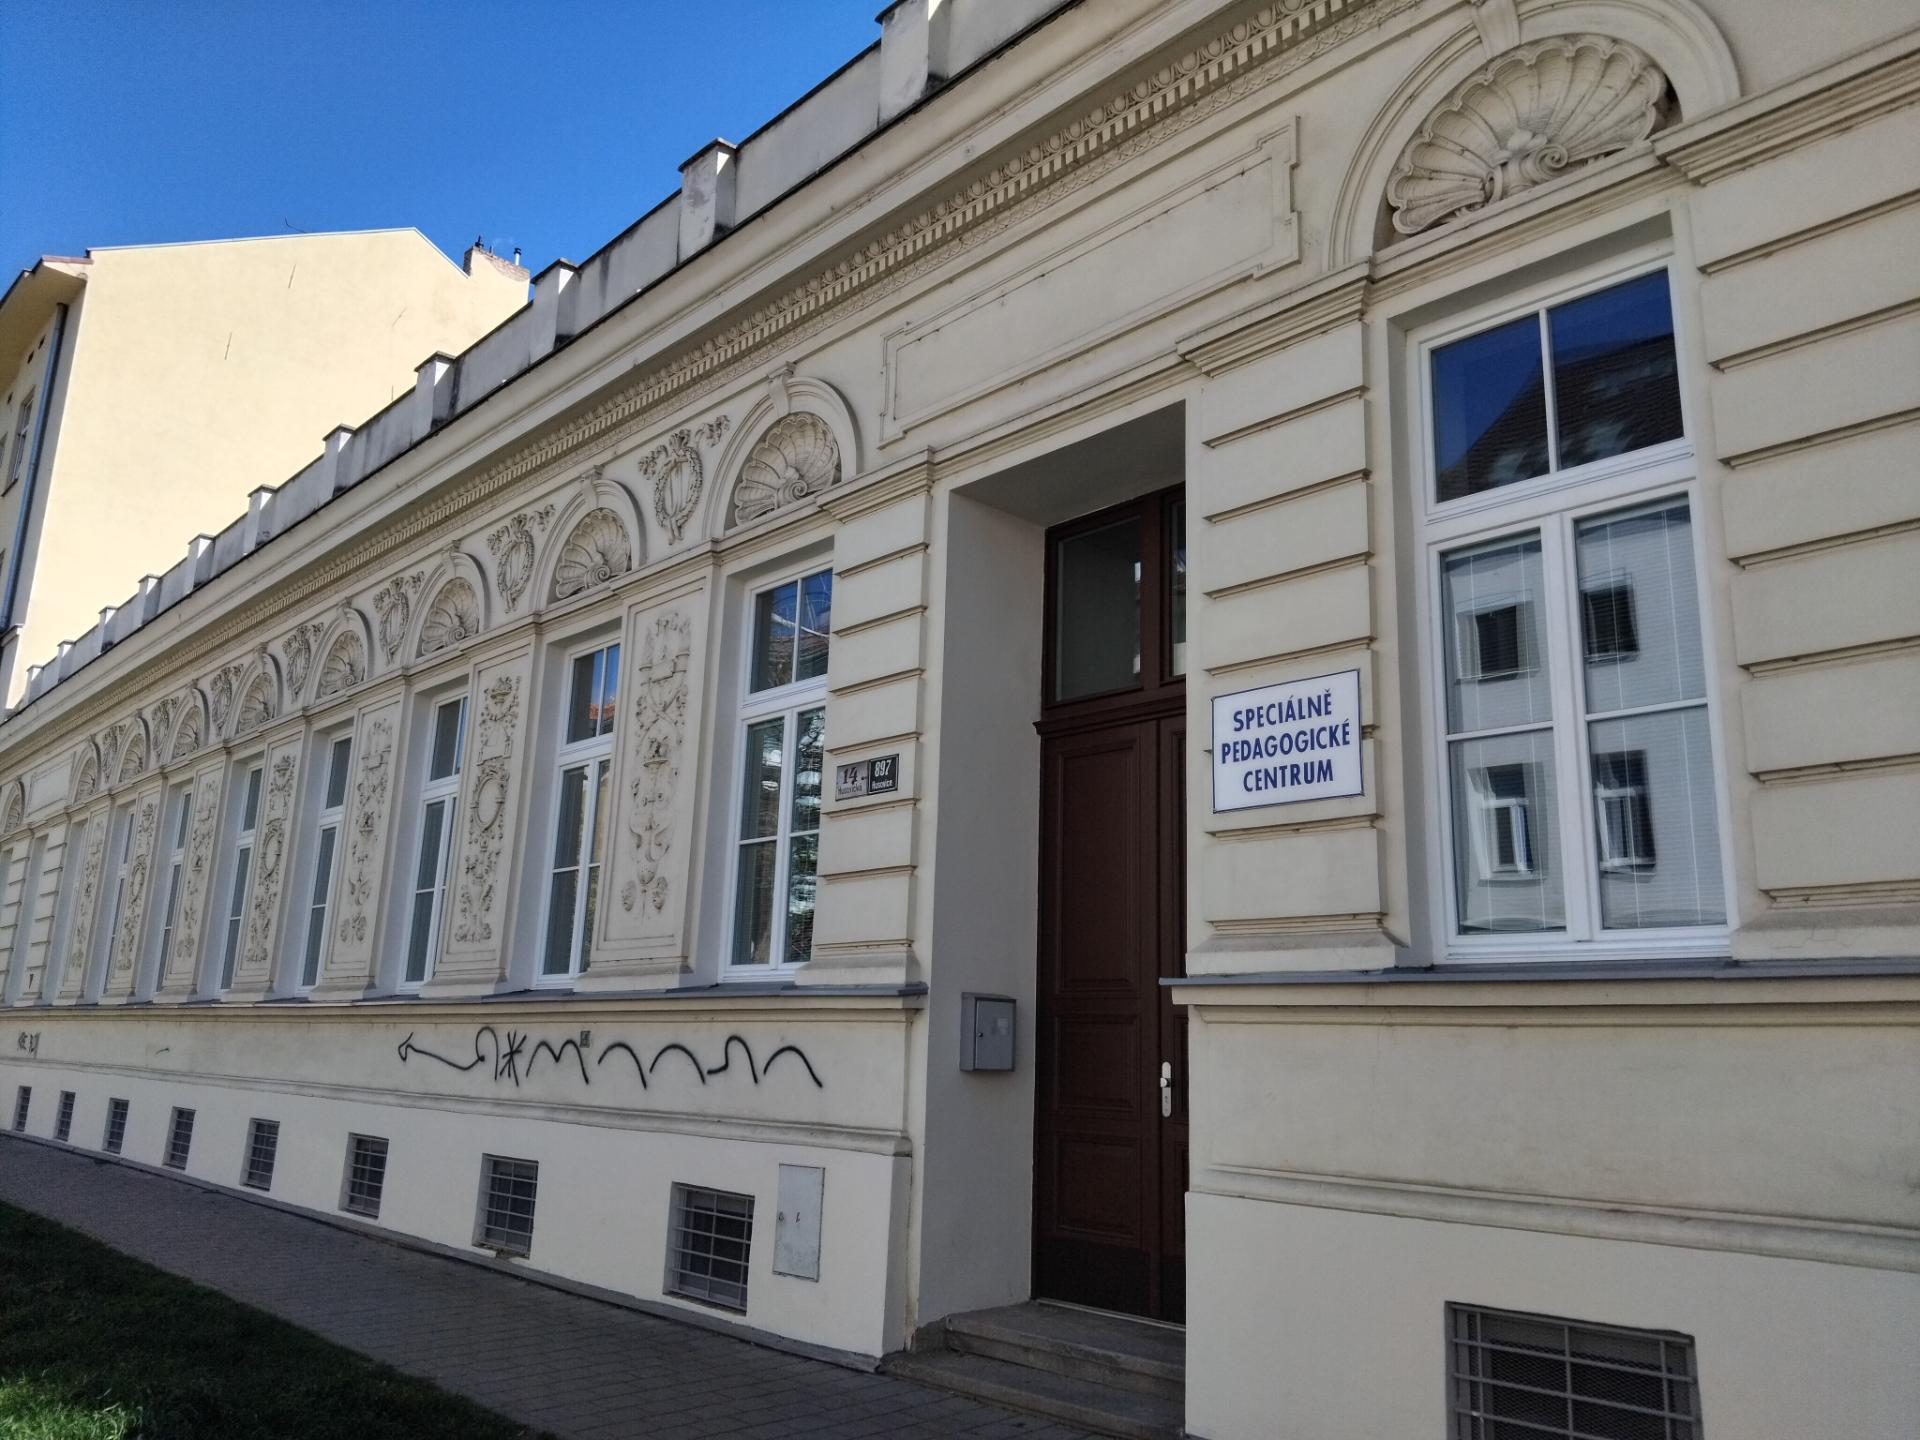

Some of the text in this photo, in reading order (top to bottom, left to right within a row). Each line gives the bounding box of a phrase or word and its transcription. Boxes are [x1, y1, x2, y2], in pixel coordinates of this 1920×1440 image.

[1233, 688, 1332, 732] SPECIÁLNĚ
[1221, 718, 1350, 764] PEDAGOGICKÉ
[843, 767, 858, 785] 14
[874, 760, 891, 777] 897
[1243, 759, 1334, 792] CENTRUM
